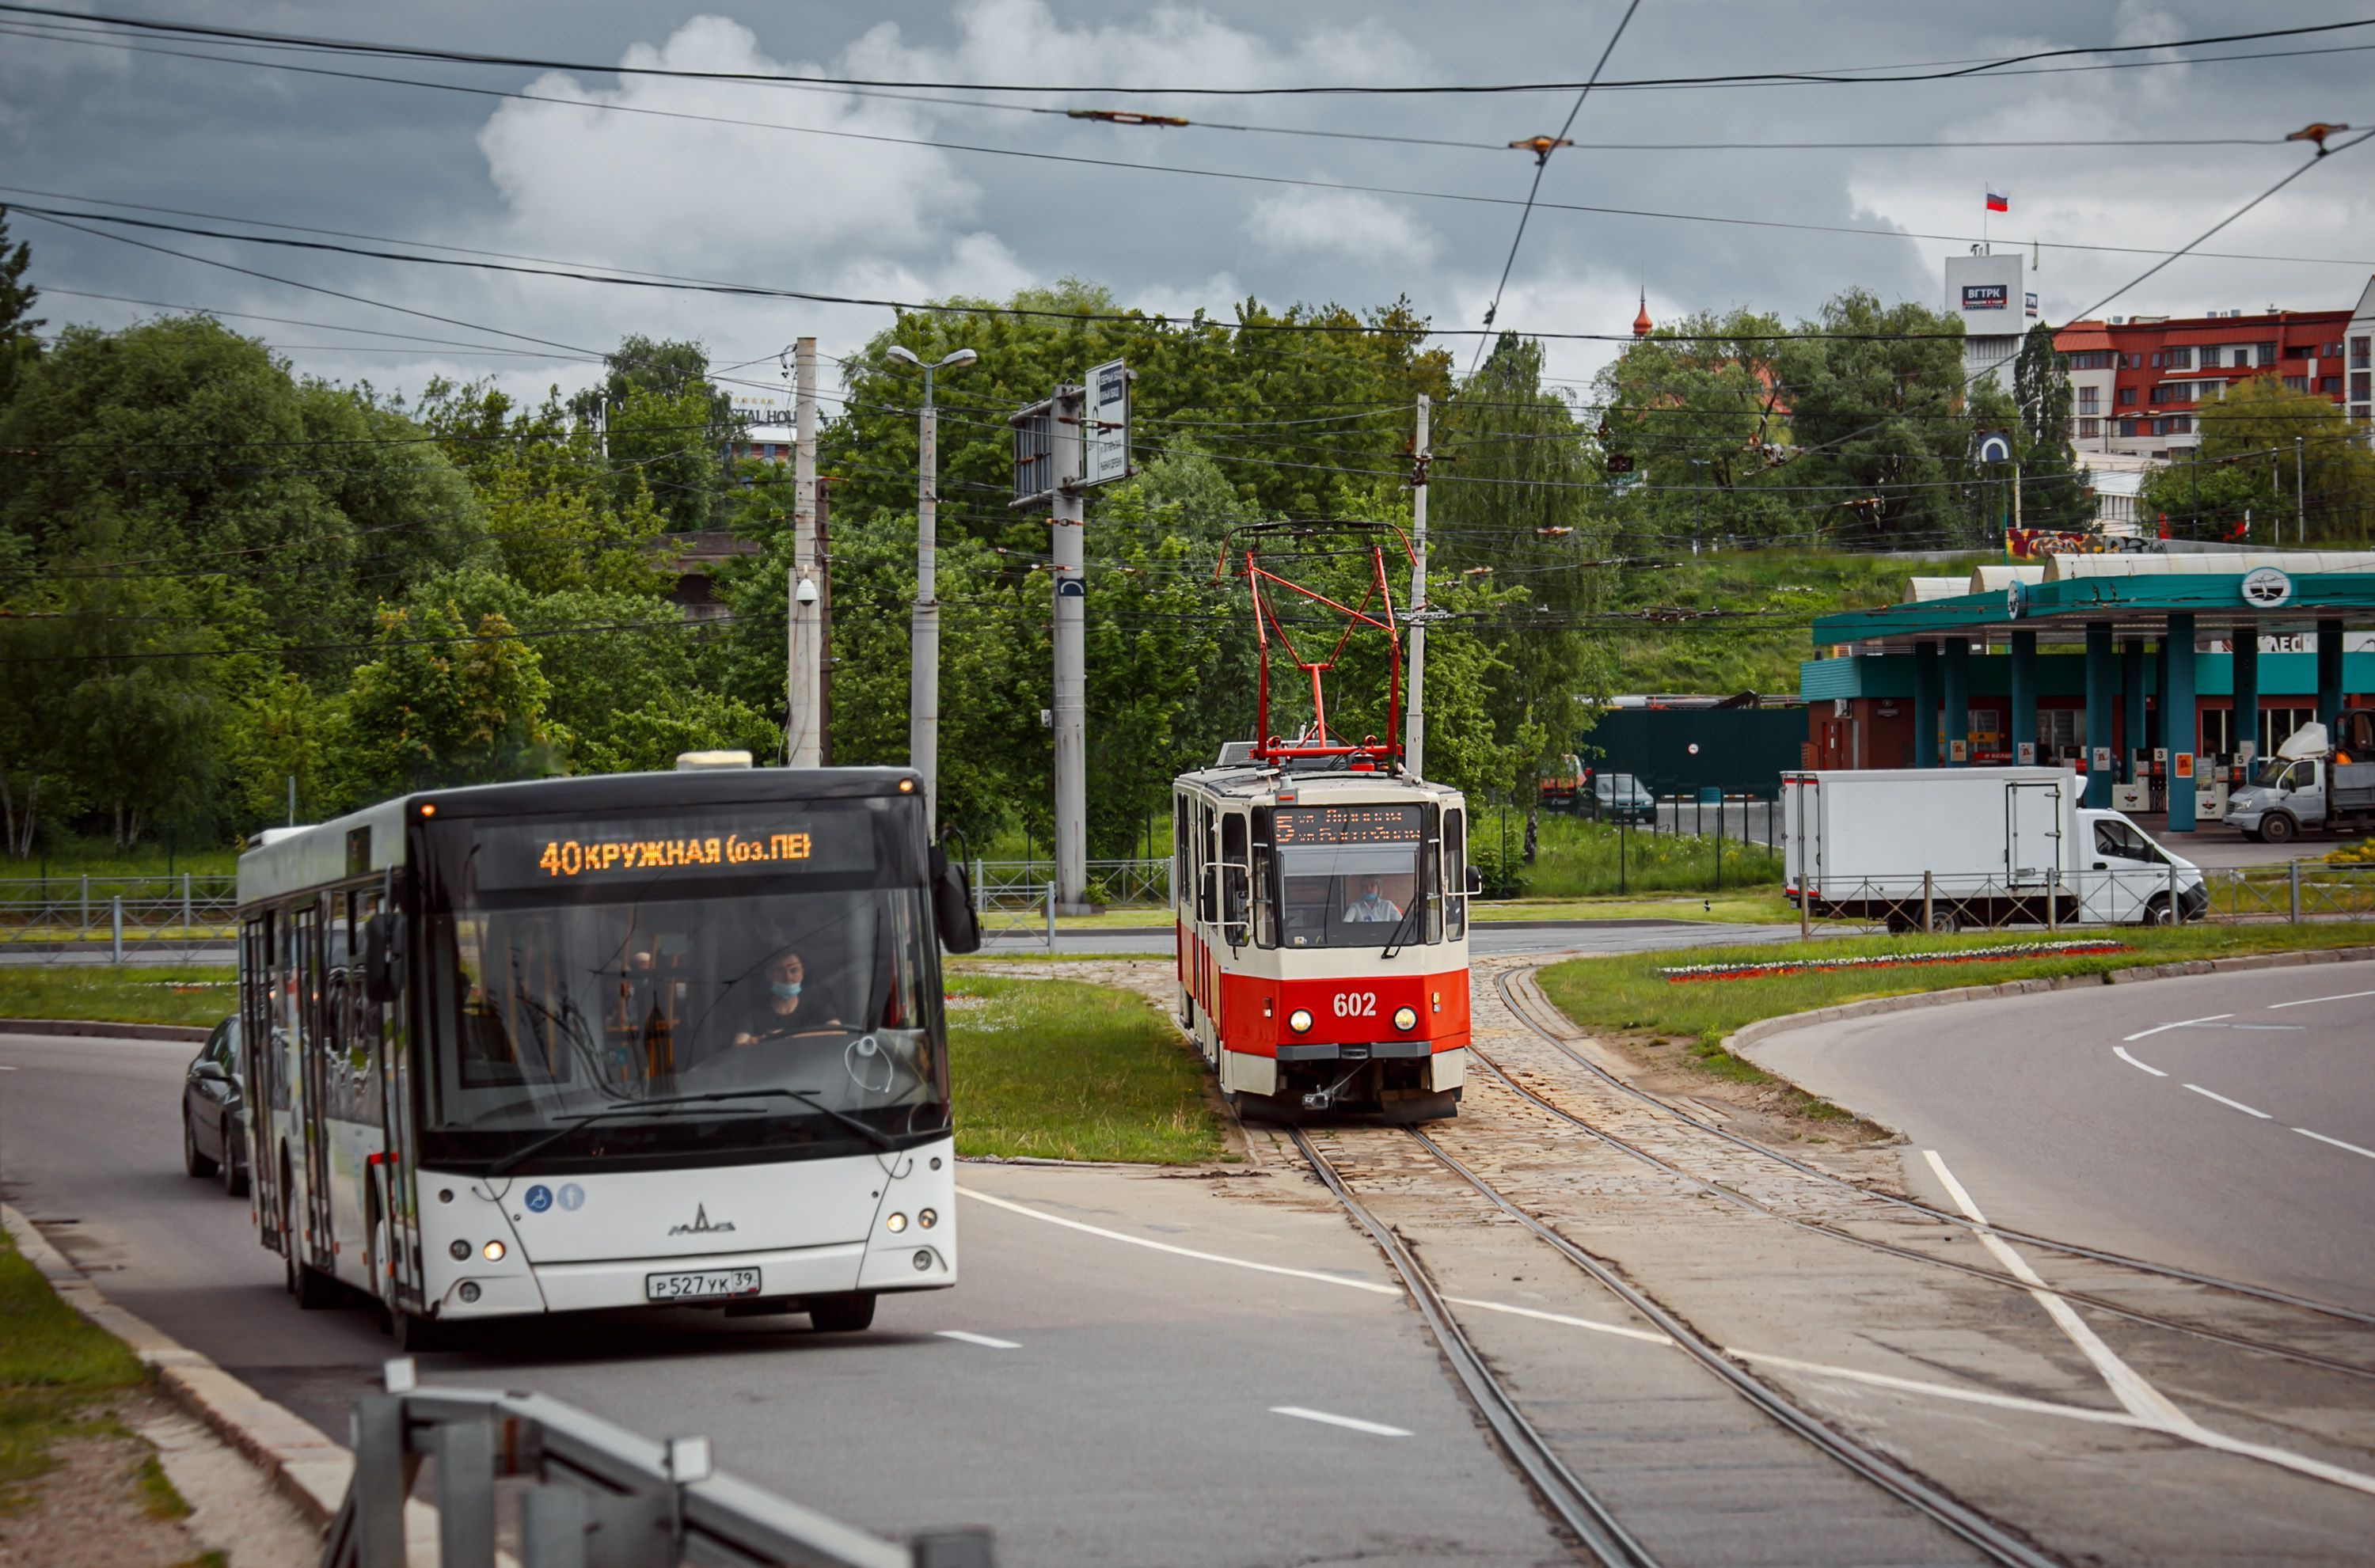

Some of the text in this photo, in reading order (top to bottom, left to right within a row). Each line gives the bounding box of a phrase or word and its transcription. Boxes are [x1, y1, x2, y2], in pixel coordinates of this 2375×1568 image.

[1968, 288, 2001, 298] ВГТРК
[2157, 750, 2164, 759] 3
[2237, 755, 2244, 764] 5
[1276, 815, 1295, 843] 5
[540, 841, 582, 876] 40
[584, 838, 721, 871] КРУЖНАЯ
[1333, 992, 1377, 1017] 602
[734, 1272, 753, 1287] 39
